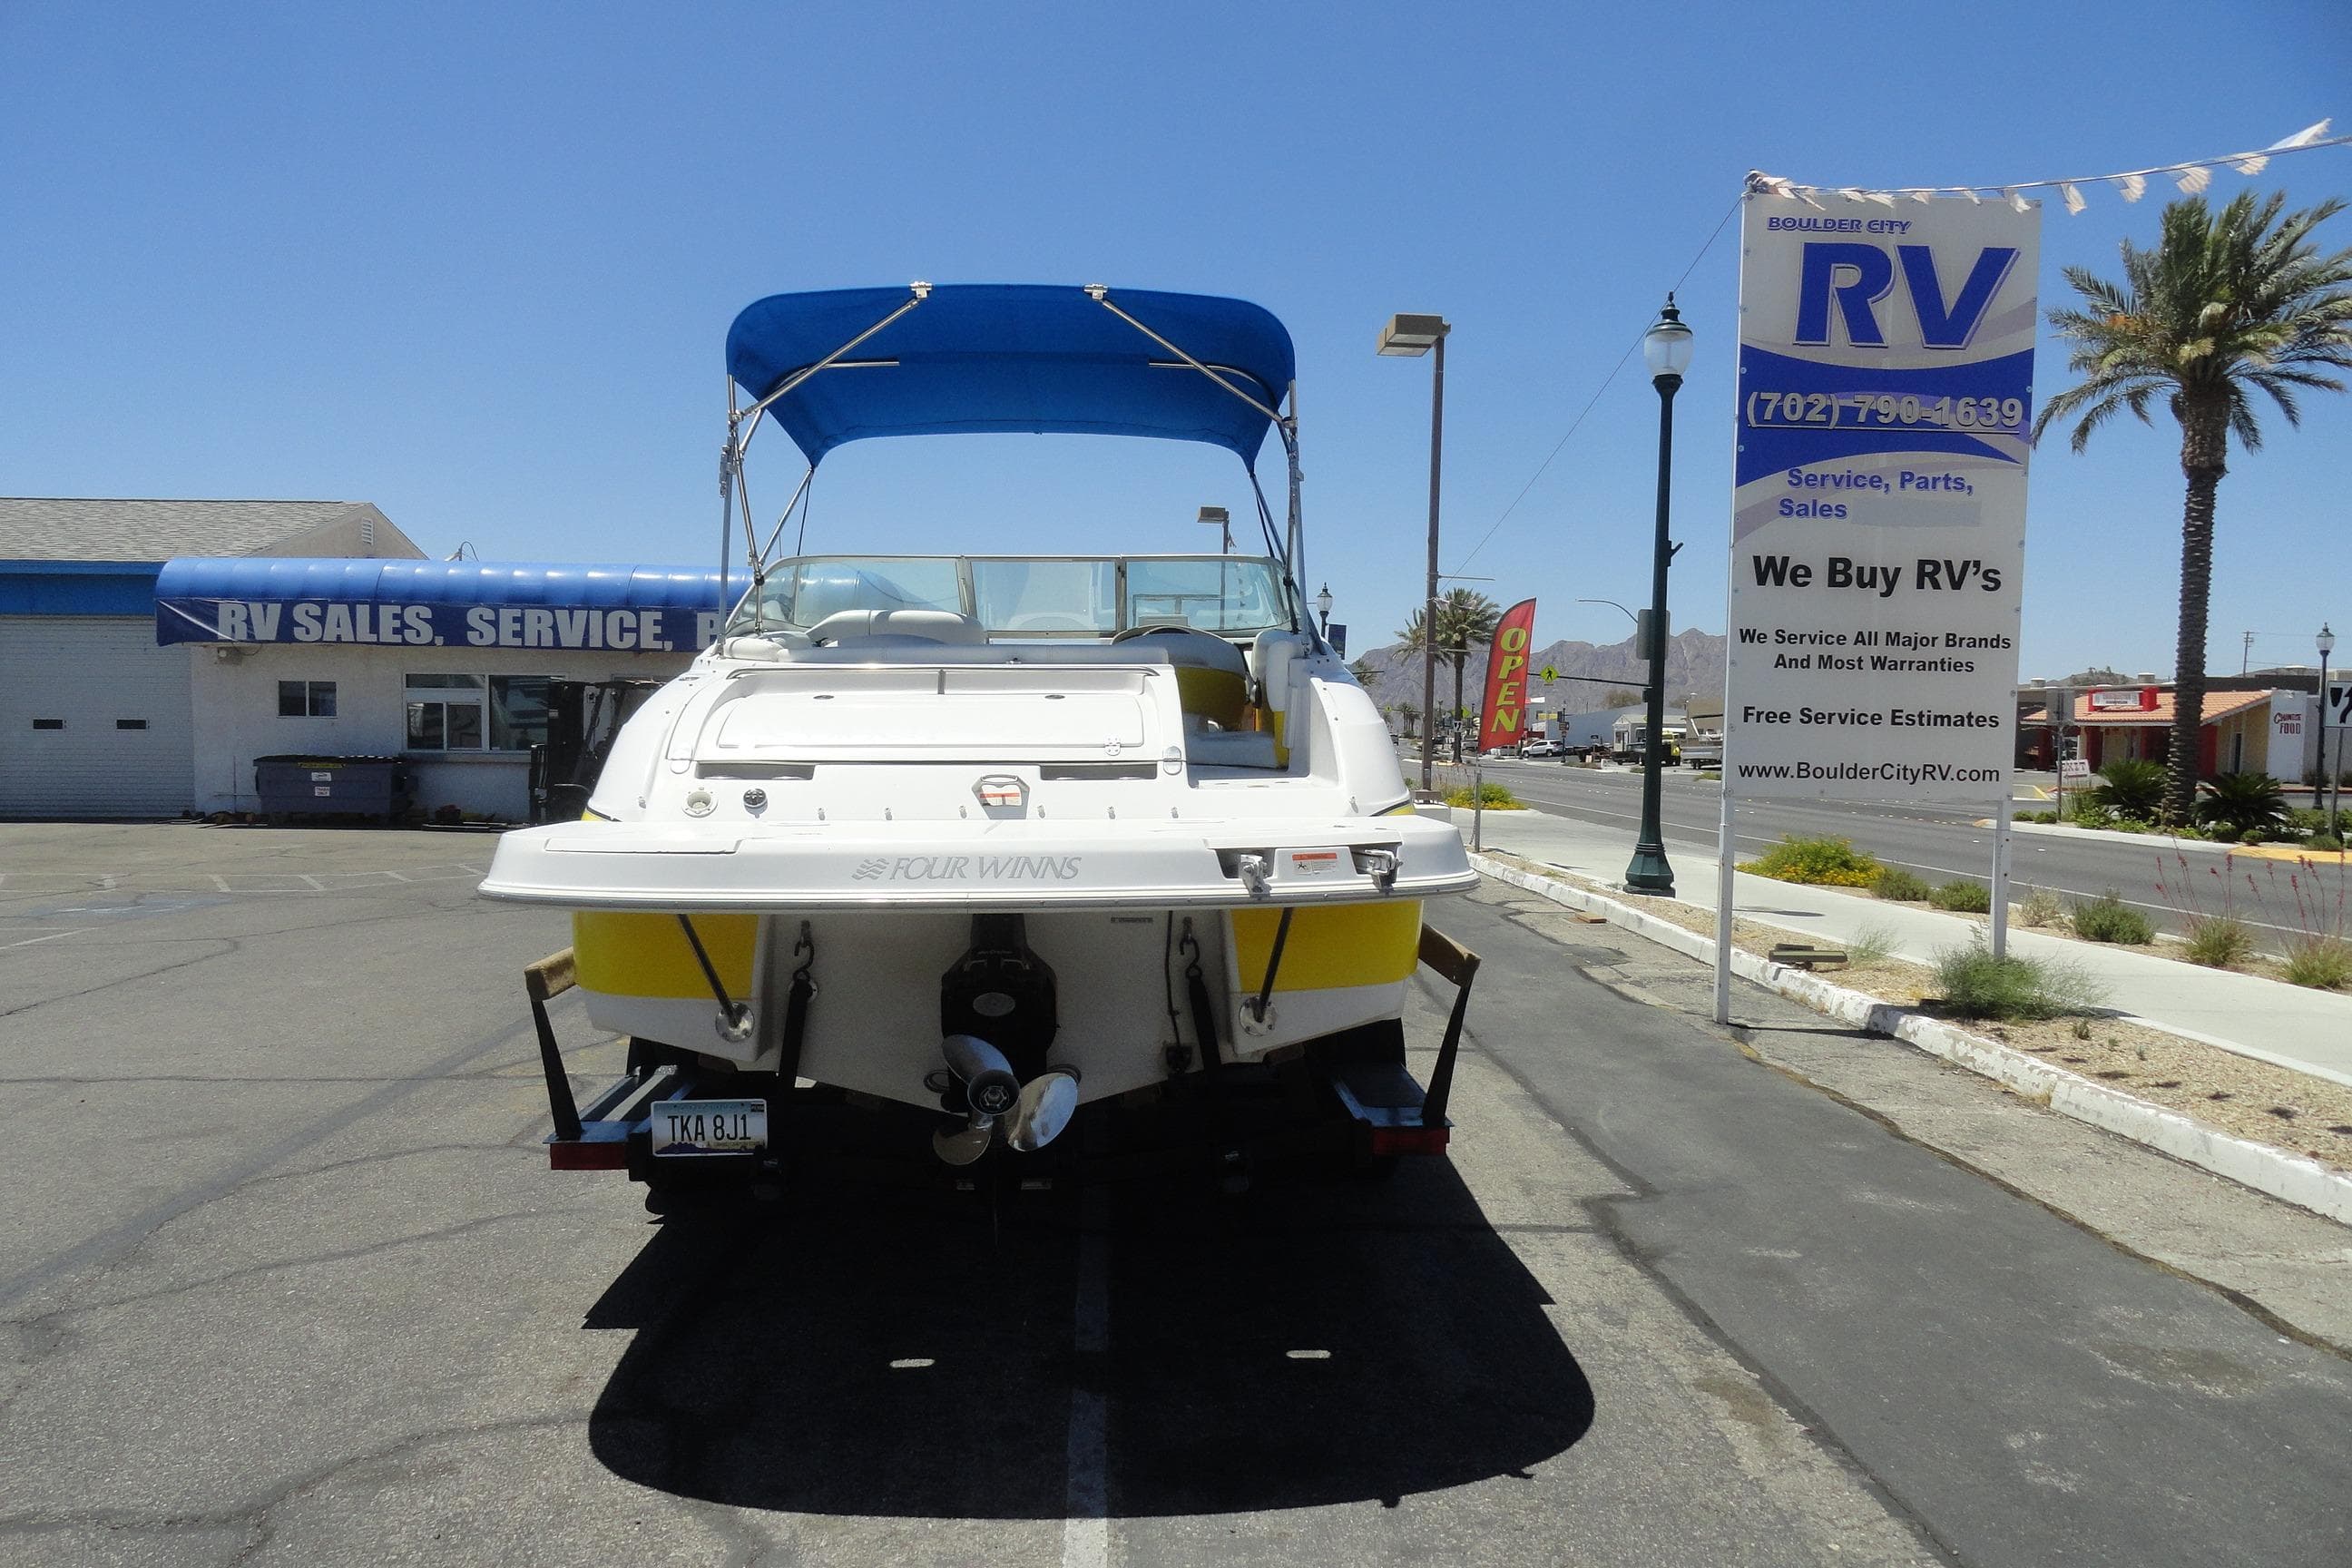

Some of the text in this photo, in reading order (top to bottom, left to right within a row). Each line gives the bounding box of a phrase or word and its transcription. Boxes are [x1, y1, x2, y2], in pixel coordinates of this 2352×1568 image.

[1767, 216, 1913, 234] BOULDER CITY
[1793, 241, 2021, 350] RV
[1747, 390, 2024, 429] (702) 790-1639
[1787, 467, 1974, 495] Service, Parts,
[1779, 498, 1848, 519] Sales
[1753, 555, 2003, 597] We Buy RV's
[217, 603, 283, 642] RV
[293, 604, 444, 647] SALES,
[466, 606, 673, 652] SERVICE,
[1740, 628, 2011, 651] We Service All Major Brands
[1774, 653, 1975, 672] And Most Warranties
[1491, 627, 1526, 732] OPEN
[1742, 706, 2000, 728] Free Service Estimates
[2279, 722, 2301, 734] FOOD
[1738, 761, 2000, 785] www.BoulderCityRV.com
[888, 856, 1083, 880] FOUR WINNS
[667, 1113, 752, 1142] TKA 8J1
